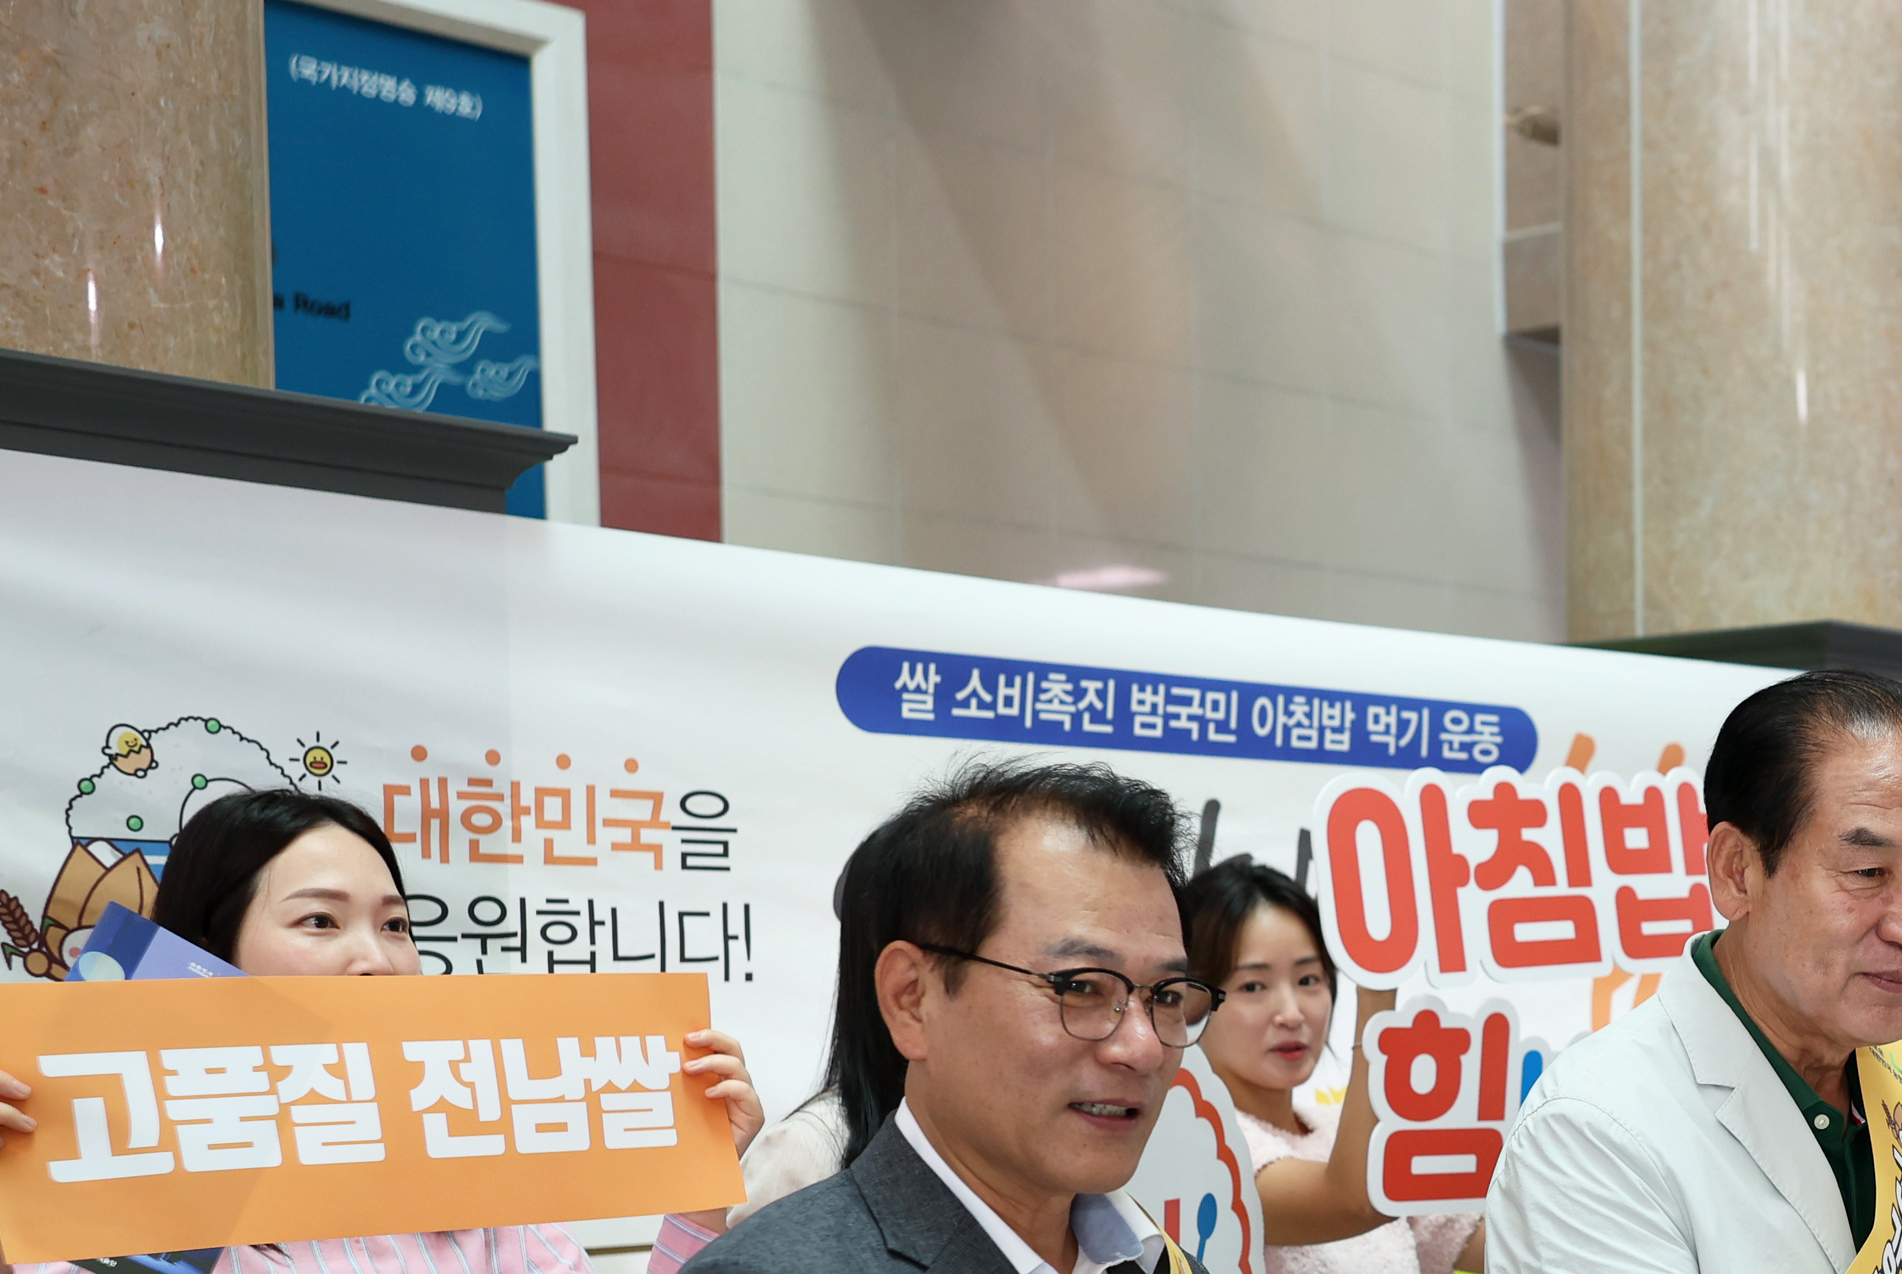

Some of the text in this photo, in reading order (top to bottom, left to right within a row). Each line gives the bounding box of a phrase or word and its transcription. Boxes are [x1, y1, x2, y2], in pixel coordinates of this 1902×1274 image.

[894, 660, 1503, 765] 쌀 소비촉진 범국민 아침밥 먹기 운동
[383, 776, 738, 873] 대한민국을
[1327, 781, 1716, 976] 아침밥
[36, 1035, 681, 1184] 고품질 전남쌀
[1377, 1008, 1511, 1203] 힘
